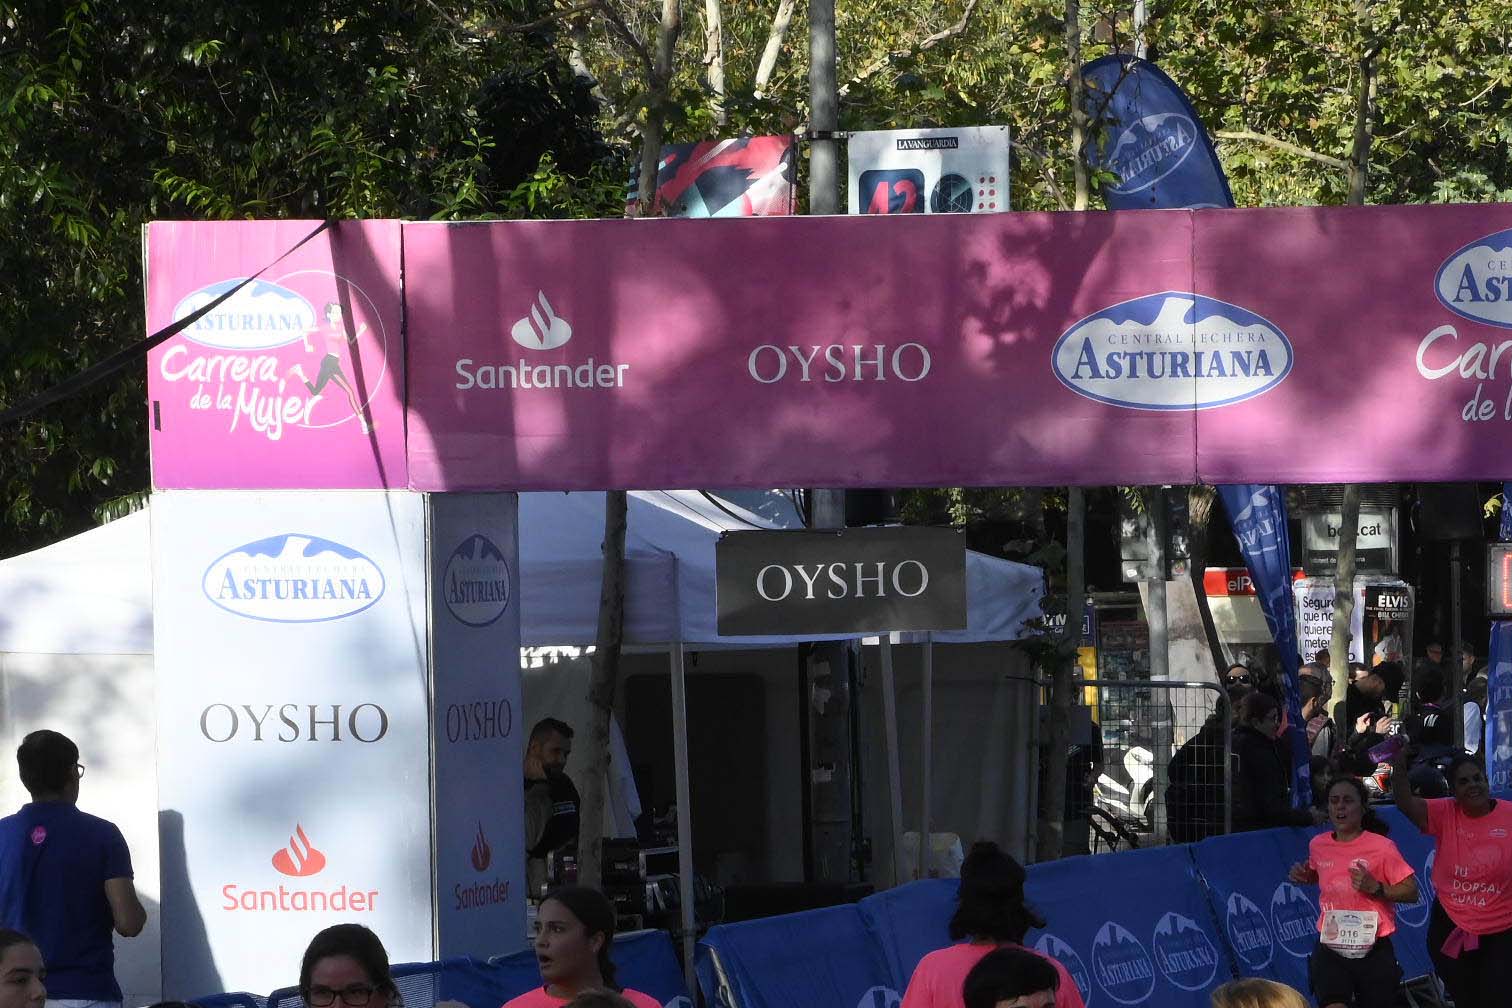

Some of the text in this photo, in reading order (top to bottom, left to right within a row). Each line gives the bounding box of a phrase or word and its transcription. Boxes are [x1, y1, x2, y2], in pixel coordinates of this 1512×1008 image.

[1108, 330, 1267, 345] CENTRAL LECHERA
[160, 344, 281, 383] Carrera
[456, 358, 630, 390] Santander
[748, 343, 932, 384] OYSHO
[1071, 336, 1274, 381] ASTURIANA
[190, 378, 323, 441] de la Mujer
[1462, 383, 1496, 421] de
[219, 567, 371, 602] ASTURIANA
[447, 569, 507, 604] ASTURIANA
[756, 560, 930, 602] OYSHO
[1304, 611, 1319, 623] que
[1378, 595, 1409, 608] ELVIS
[200, 702, 389, 743] OYSHO
[447, 700, 513, 744] OYSHO
[222, 885, 379, 912] Santander
[455, 877, 510, 912] Santander
[1450, 893, 1487, 907] SUMA
[1453, 880, 1503, 895] DORSAL
[1340, 929, 1359, 939] 016
[1098, 958, 1153, 987] ASTURIANA
